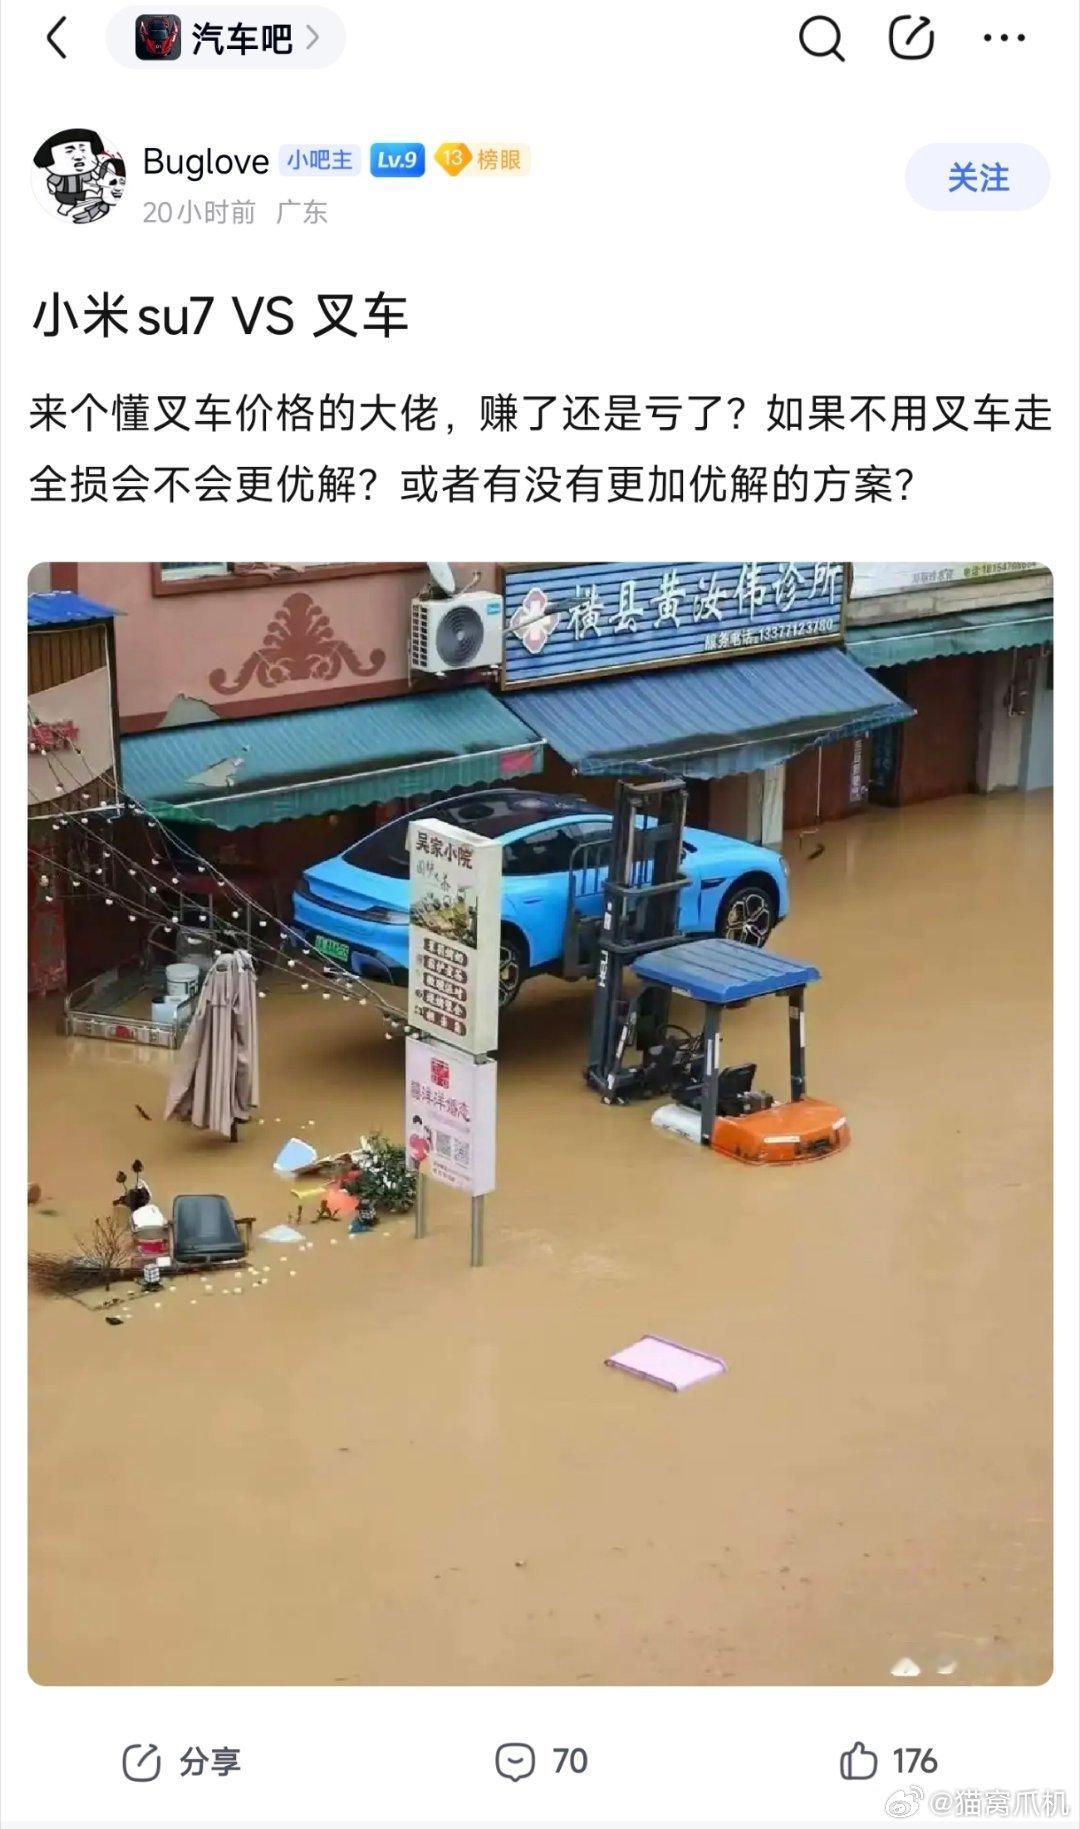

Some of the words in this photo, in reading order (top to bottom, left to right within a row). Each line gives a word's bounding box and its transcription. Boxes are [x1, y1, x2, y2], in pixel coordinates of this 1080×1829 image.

[192, 21, 293, 57] 汽车吧
[143, 147, 269, 183] Buglove
[287, 148, 353, 171] 小吧主
[377, 151, 418, 169] Lv.9
[443, 149, 464, 166] 13
[477, 148, 521, 171] 榜眼
[948, 161, 1010, 194] 关注
[143, 199, 256, 225] 20小时前
[277, 199, 328, 225] 广东
[32, 290, 214, 339] 小米su7
[231, 294, 295, 336] VS
[312, 290, 409, 339] 叉车
[416, 831, 473, 870] 吴家小院
[179, 1745, 242, 1778] 分享
[552, 1746, 589, 1775] 70
[893, 1747, 939, 1774] 176
